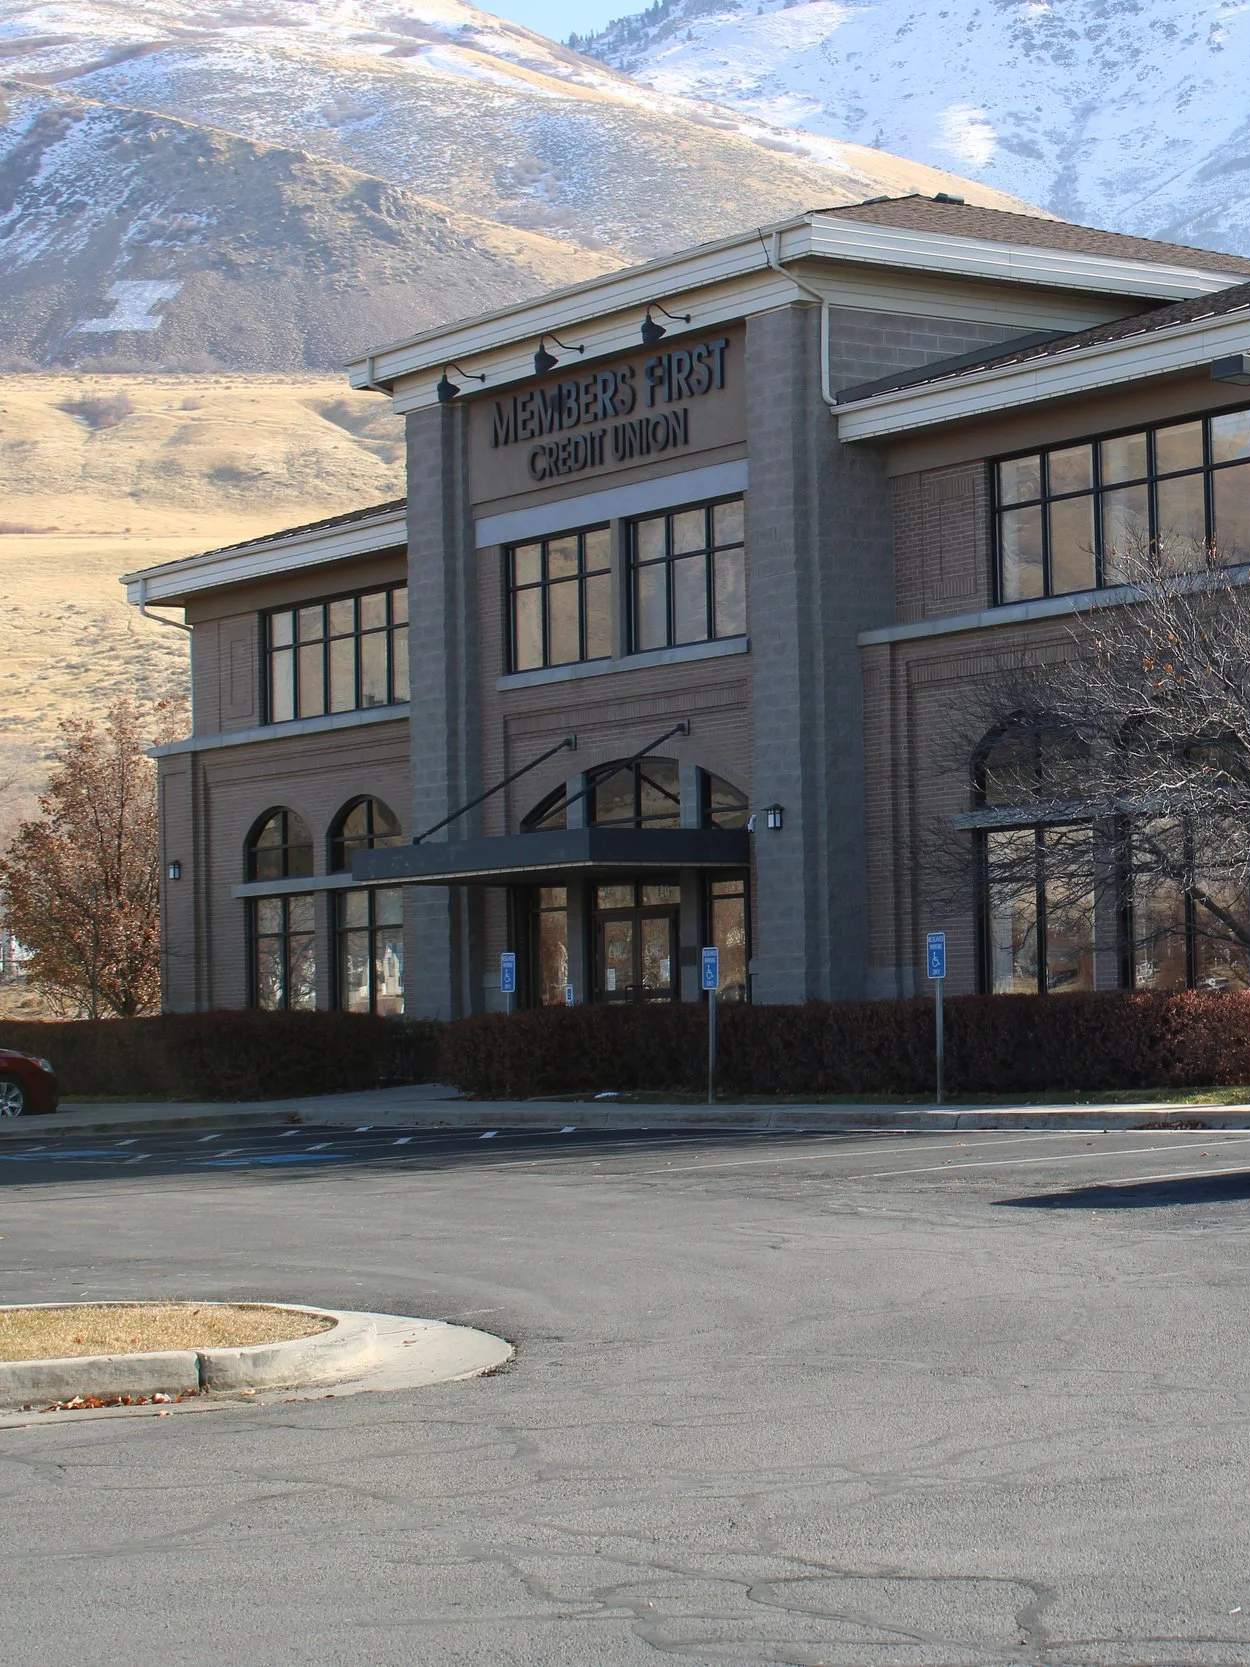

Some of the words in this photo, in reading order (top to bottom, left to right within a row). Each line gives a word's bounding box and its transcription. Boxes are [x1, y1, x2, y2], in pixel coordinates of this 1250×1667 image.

[490, 364, 635, 448] MEMBERS
[644, 338, 728, 407] FIRST
[528, 428, 607, 481] CREDIT
[611, 408, 689, 461] UNION
